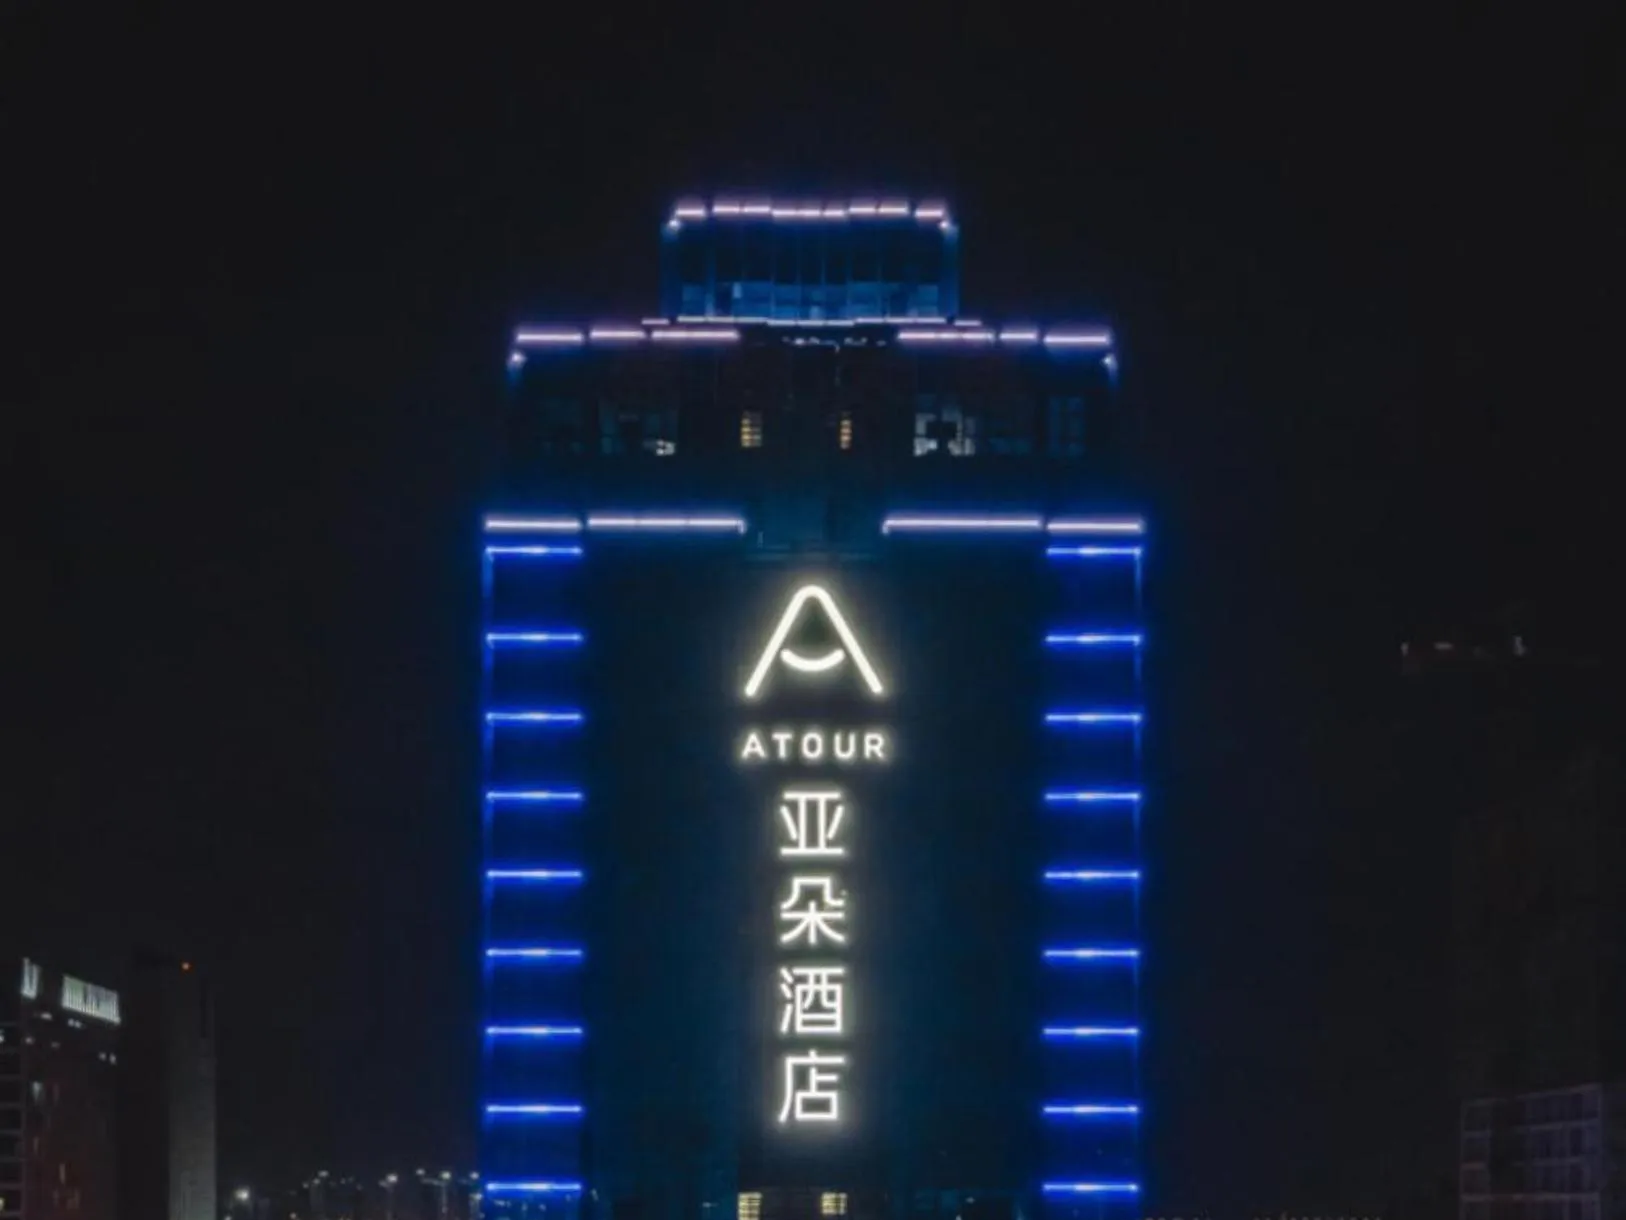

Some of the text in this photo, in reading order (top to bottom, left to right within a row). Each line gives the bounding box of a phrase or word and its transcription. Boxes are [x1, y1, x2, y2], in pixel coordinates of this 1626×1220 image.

[740, 731, 887, 761] ATOUR
[777, 789, 847, 1125] 亚朵酒店
